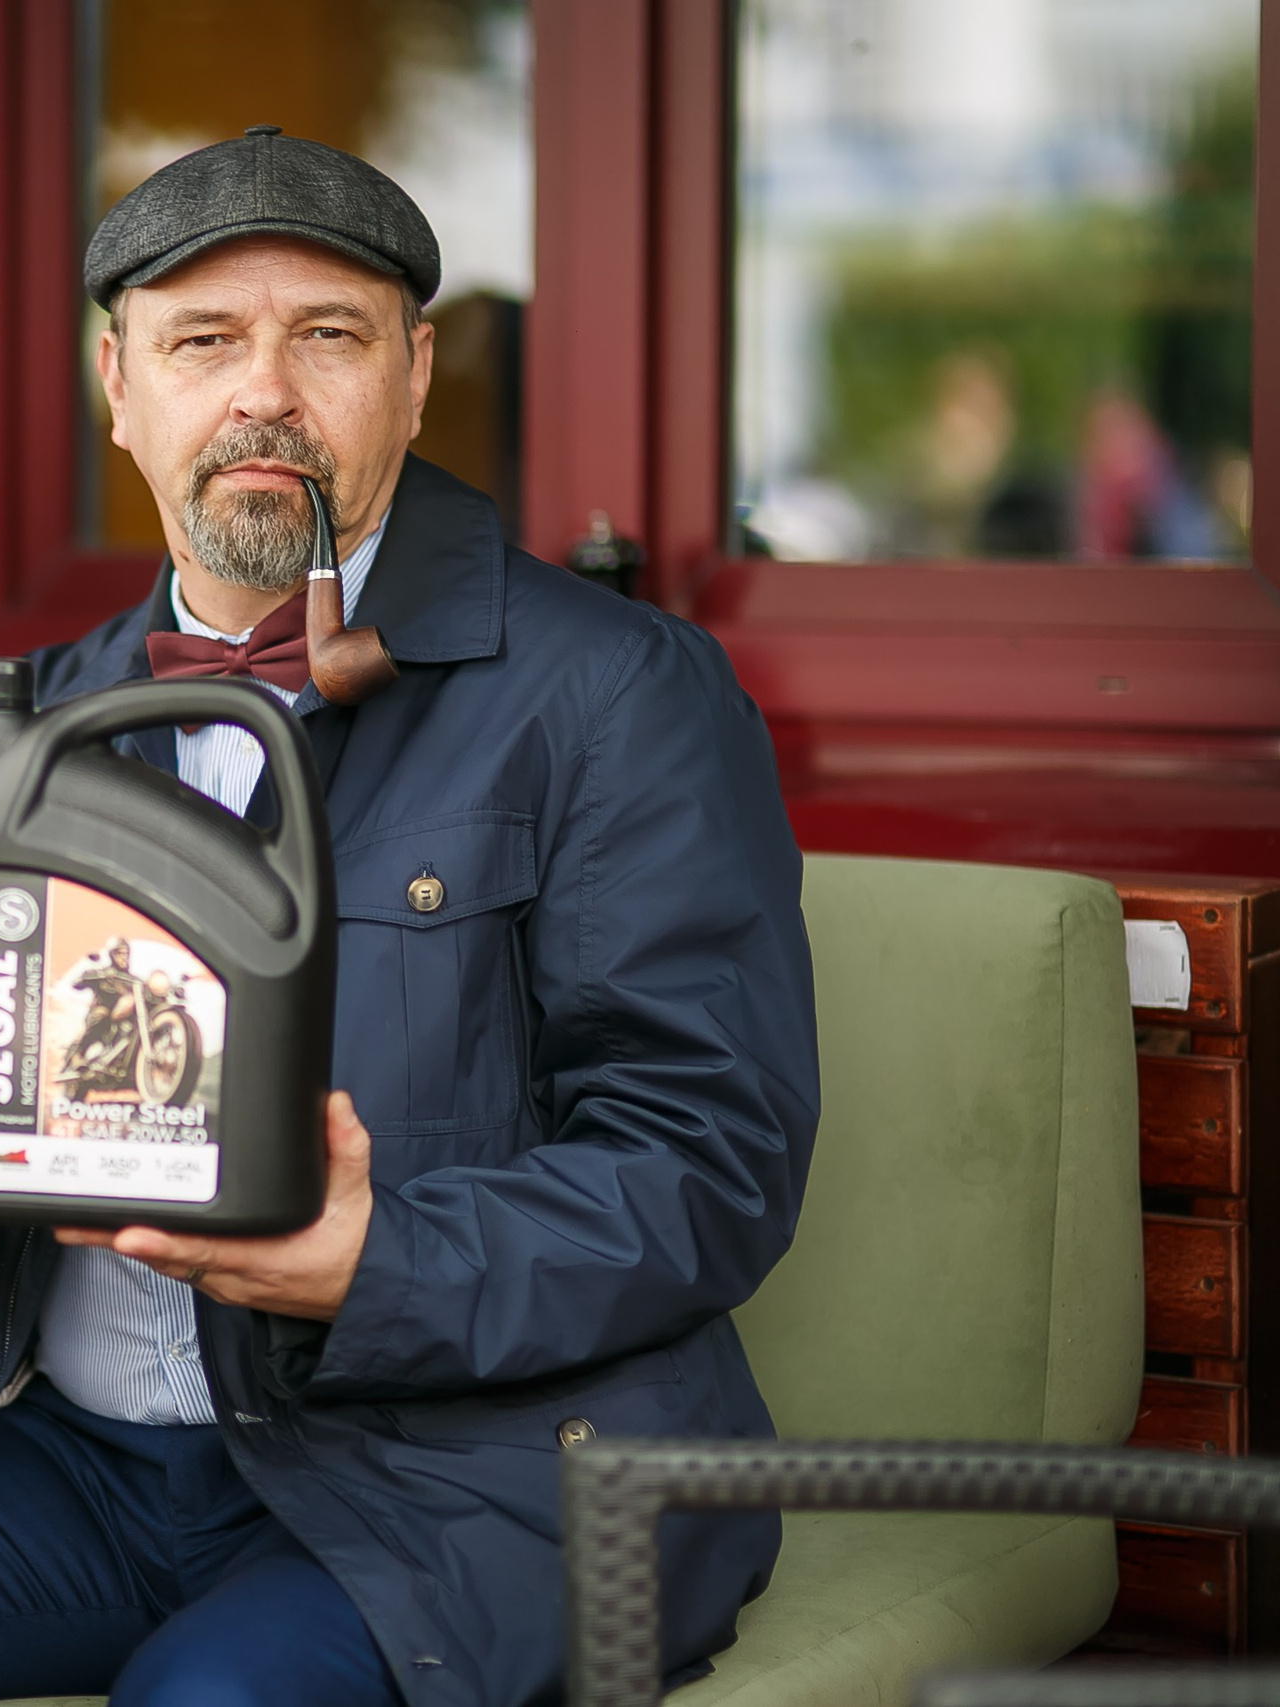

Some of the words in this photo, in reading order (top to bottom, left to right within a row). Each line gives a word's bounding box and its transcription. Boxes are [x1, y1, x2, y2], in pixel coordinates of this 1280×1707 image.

[23, 952, 43, 1054] LUBRICANTS
[21, 1054, 39, 1106] MOTO
[51, 1096, 136, 1123] Power
[138, 1102, 206, 1127] Steel
[81, 1122, 124, 1141] SAE
[126, 1125, 209, 1146] 20W-50
